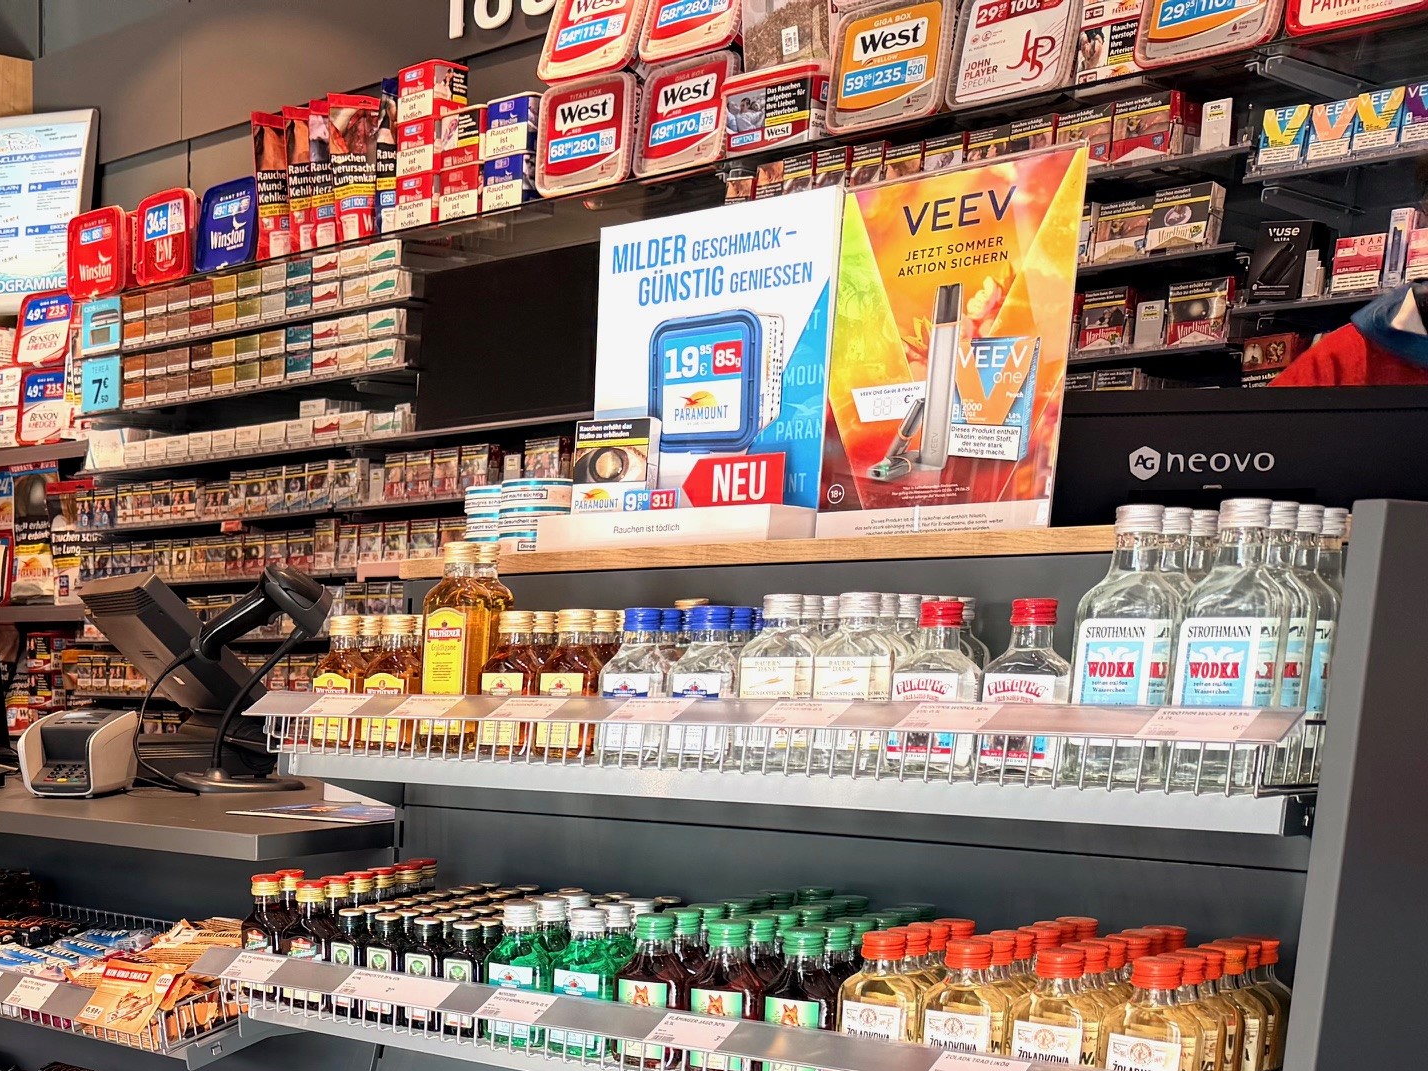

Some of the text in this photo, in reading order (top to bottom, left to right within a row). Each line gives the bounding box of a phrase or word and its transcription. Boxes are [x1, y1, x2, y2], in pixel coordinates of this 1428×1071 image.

[873, 12, 912, 27] GIGA BOX
[1113, 21, 1138, 32] Rauchen
[860, 23, 920, 54] West
[873, 54, 898, 63] YELLOW
[966, 58, 991, 71] JOHN
[691, 69, 705, 78] BOX
[907, 62, 923, 76] 520
[964, 65, 998, 81] PLAYER
[778, 82, 801, 92] Rauchen
[962, 76, 997, 90] SPECIAL
[400, 92, 426, 105] Rauchen
[569, 88, 602, 100] TITAN BOX
[664, 80, 711, 106] West
[560, 100, 608, 124] West
[490, 125, 519, 138] Rauchen
[766, 126, 790, 138] West
[500, 136, 508, 144] ist
[601, 136, 613, 146] 620
[331, 154, 366, 163] Rauchen
[400, 147, 426, 159] Rauchen
[333, 163, 376, 174] verursacht
[903, 186, 1016, 236] VEEV
[210, 229, 245, 250] Winston
[613, 227, 783, 275] MILDER GESCHMACK
[905, 237, 1003, 261] JETZT SOMMER
[898, 251, 1008, 278] AKTION SICHERN
[79, 264, 112, 282] Winston
[638, 261, 813, 306] GÜNSTIG GENIESSEN
[29, 332, 60, 344] BENSON
[715, 347, 742, 370] 85g
[959, 345, 1027, 368] VEEV
[993, 369, 1023, 384] one
[29, 412, 58, 422] BENSON
[674, 404, 729, 422] PARAMOUNT
[579, 425, 601, 433] Rauchen
[603, 424, 620, 432] erhöht
[605, 430, 630, 439] erblinden
[972, 427, 996, 435] Produkt
[1134, 452, 1275, 473] AG neovo
[712, 461, 767, 503] NEU
[830, 489, 842, 499] 18+
[575, 497, 619, 510] PARAMOUNT
[613, 523, 680, 535] Rauchen ist tödlich
[1086, 625, 1146, 638] STROTHMANN
[1187, 625, 1252, 638] STROTHMANN
[1087, 662, 1134, 679] WODKA
[1190, 662, 1240, 680] WODKA
